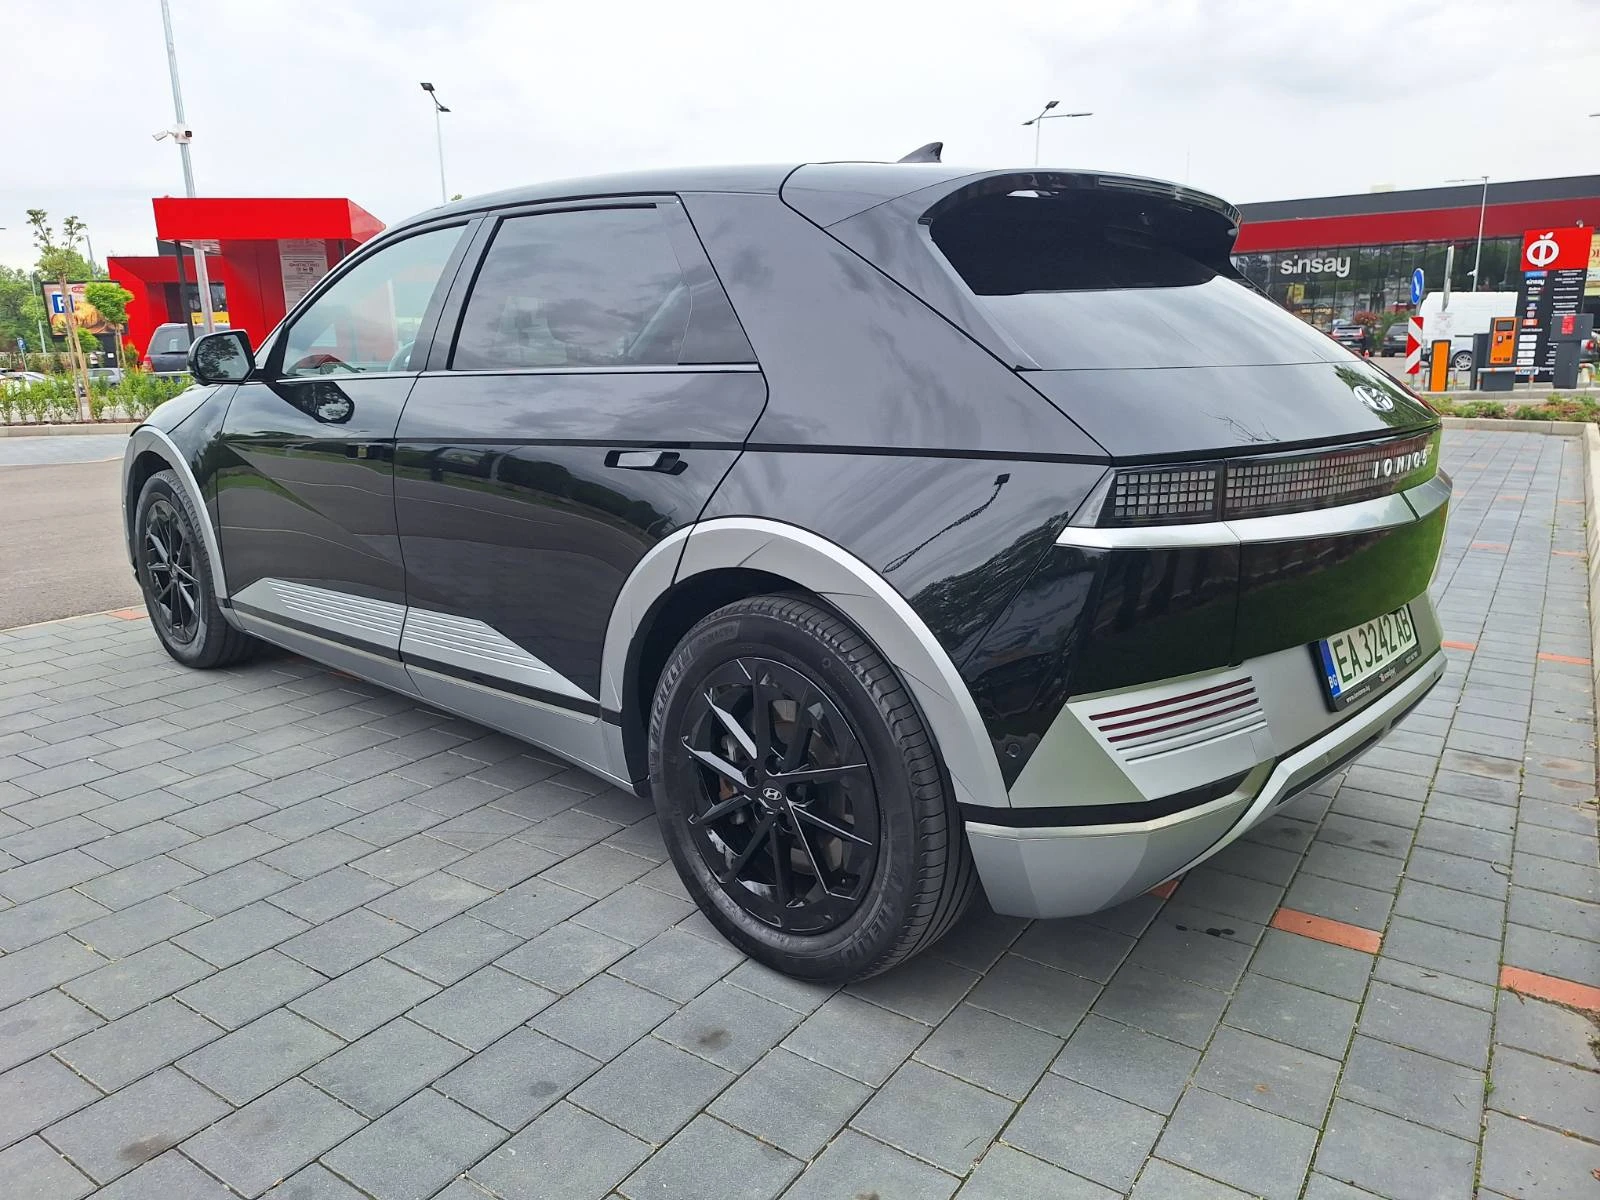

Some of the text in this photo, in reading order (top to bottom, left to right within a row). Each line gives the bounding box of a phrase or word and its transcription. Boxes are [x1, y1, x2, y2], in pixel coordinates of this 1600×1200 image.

[1280, 254, 1351, 278] sinsay
[1332, 607, 1412, 684] EA 3242 AB
[1328, 674, 1338, 689] BG
